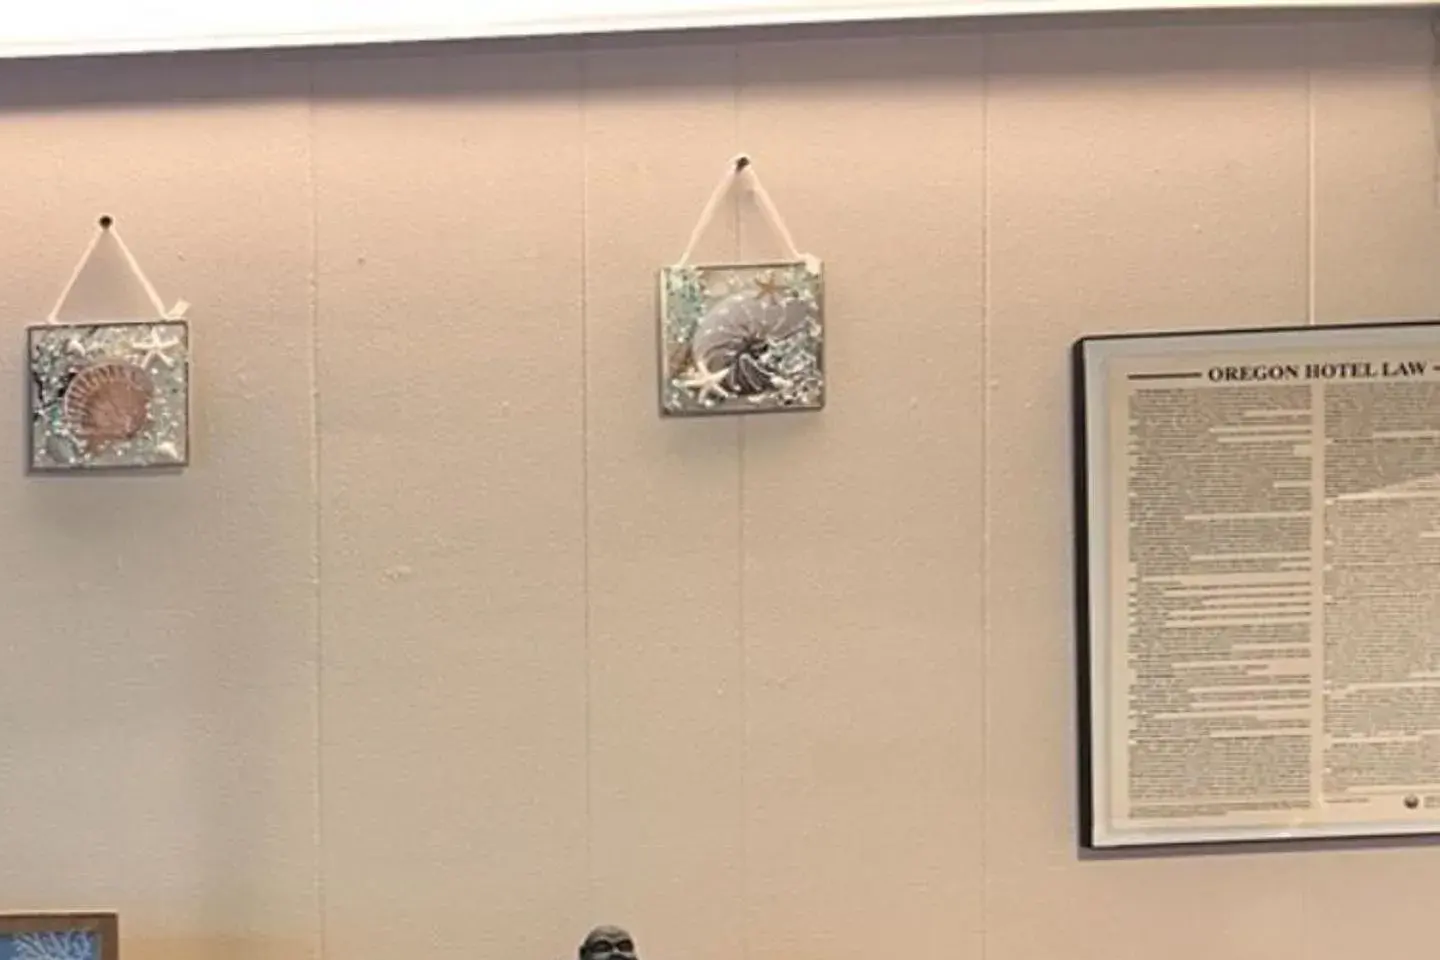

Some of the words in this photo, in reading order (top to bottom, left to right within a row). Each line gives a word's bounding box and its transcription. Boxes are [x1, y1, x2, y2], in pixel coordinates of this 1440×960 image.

[1208, 363, 1299, 382] OREGON
[1305, 361, 1378, 380] HOTEL
[1381, 360, 1427, 378] LAW
